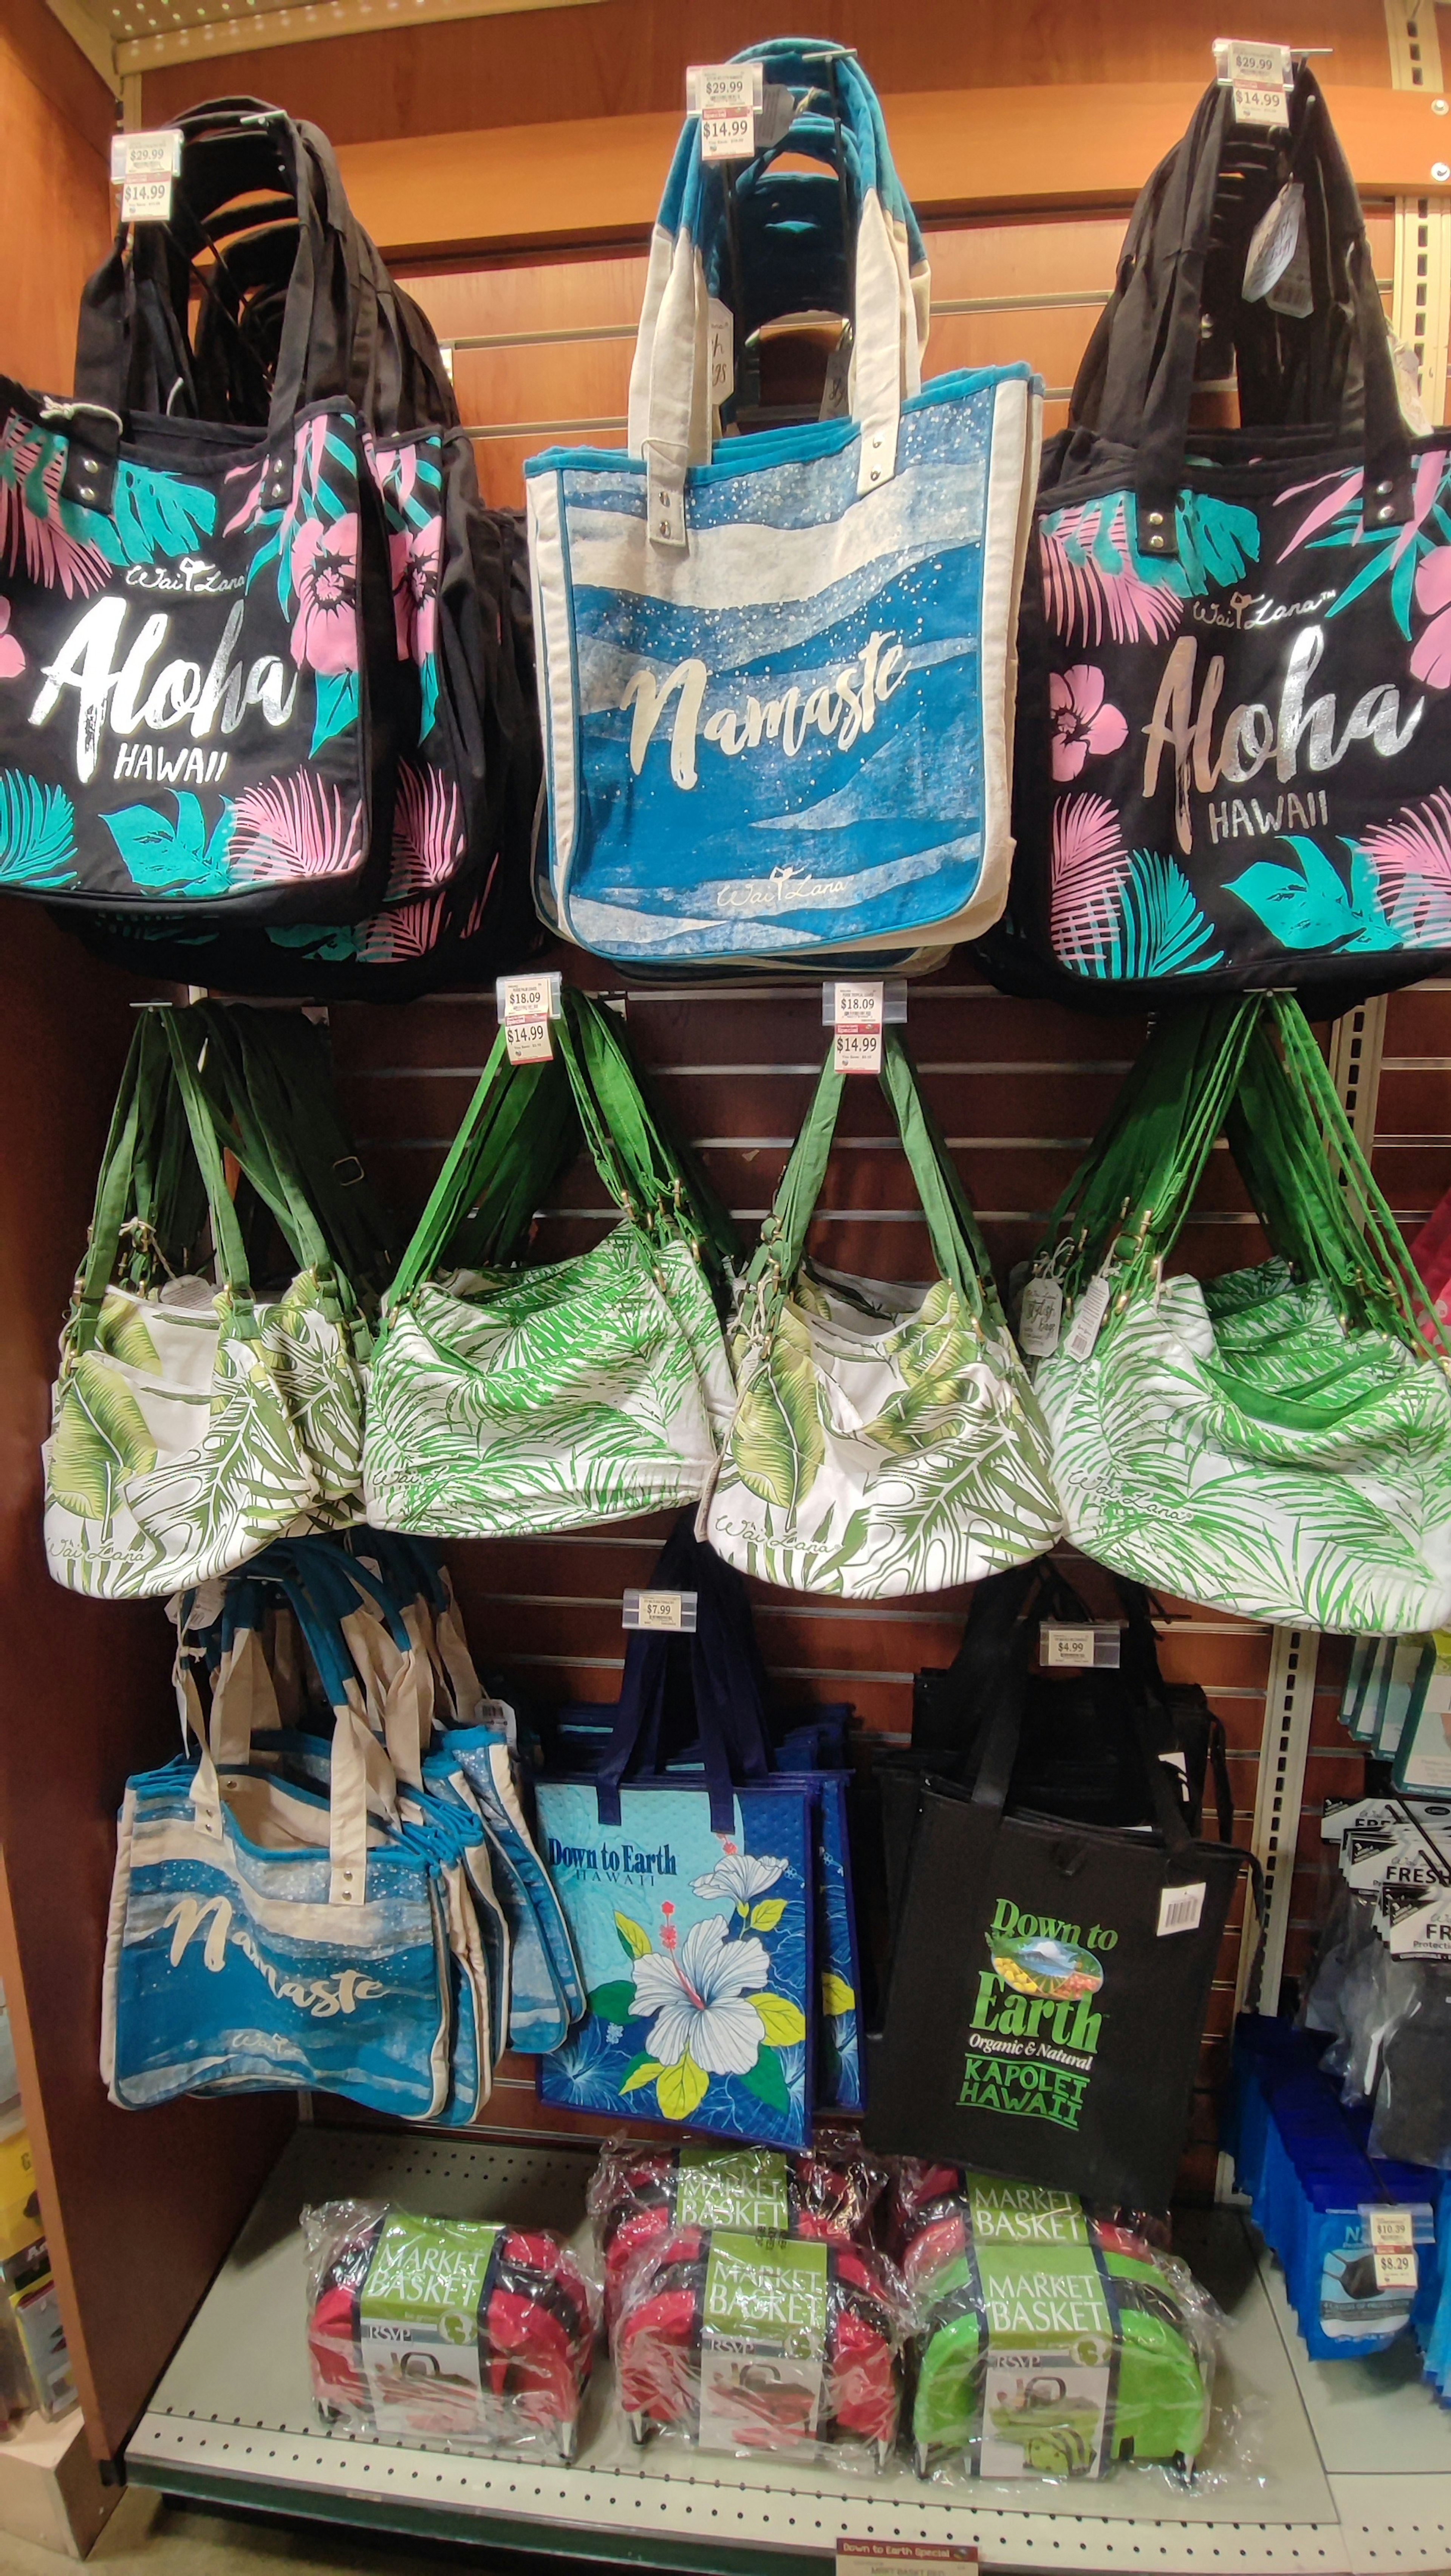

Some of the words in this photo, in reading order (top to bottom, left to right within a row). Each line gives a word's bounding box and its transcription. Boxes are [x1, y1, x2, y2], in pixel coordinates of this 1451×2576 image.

[1236, 56, 1272, 70] $29.99
[706, 81, 743, 95] $29.99
[1236, 88, 1280, 107] $14.99
[703, 120, 748, 139] $14.99
[130, 148, 164, 161] $29.99
[124, 185, 165, 202] $14.99
[126, 565, 181, 591] Wai
[195, 568, 245, 593] Lana
[1193, 601, 1234, 629] Wai
[1244, 600, 1320, 630] Lana
[27, 596, 298, 783] Aloha
[619, 631, 911, 790] Namaste
[1141, 624, 1425, 855] Aloha
[114, 742, 229, 784] HAWAII
[1209, 790, 1328, 844] HAWAII
[718, 883, 775, 907] Wai
[784, 874, 847, 899] Lana
[509, 992, 541, 1005] $18.09
[841, 998, 874, 1010] $18.09
[507, 1025, 544, 1045] $14.99
[837, 1036, 877, 1054] $14.99
[1068, 1470, 1118, 1498] Wai
[1123, 1492, 1186, 1520] Lana
[715, 1515, 765, 1542] Wai
[770, 1530, 835, 1553] Lana
[87, 1542, 150, 1561] Lana
[647, 1604, 671, 1614] $7.99
[1058, 1642, 1083, 1652] $4.99
[548, 1838, 598, 1870] Down
[601, 1842, 620, 1871] to
[622, 1844, 677, 1876] Earth
[576, 1869, 654, 1887] HAWAII
[990, 1897, 1080, 1945] Down
[1086, 1923, 1119, 1951] to
[164, 1896, 391, 2018] Namaste
[969, 1970, 1104, 2054] Earth
[969, 2033, 1024, 2056] Organic
[1024, 2043, 1036, 2056] &
[1036, 2044, 1094, 2070] Natural
[964, 2058, 1088, 2104] KAPOLEI
[959, 2081, 1083, 2126] HAWAII
[682, 2177, 783, 2200] MARKET
[975, 2187, 1074, 2211] MARKET
[681, 2198, 783, 2228] BASKET
[975, 2211, 1081, 2241] BASKET
[378, 2243, 486, 2277] MARKET
[1381, 2257, 1409, 2270] $8.29
[365, 2270, 480, 2307] BASKET
[713, 2259, 822, 2293] MARKET
[988, 2275, 1095, 2299] MARKET
[710, 2283, 823, 2324] BASKET
[990, 2301, 1103, 2331] BASKET
[368, 2325, 412, 2342] RSVP
[995, 2356, 1041, 2369] RSVP
[843, 2542, 870, 2553] Down
[872, 2545, 884, 2554] to
[886, 2545, 913, 2555] Earth
[915, 2547, 950, 2558] Special
